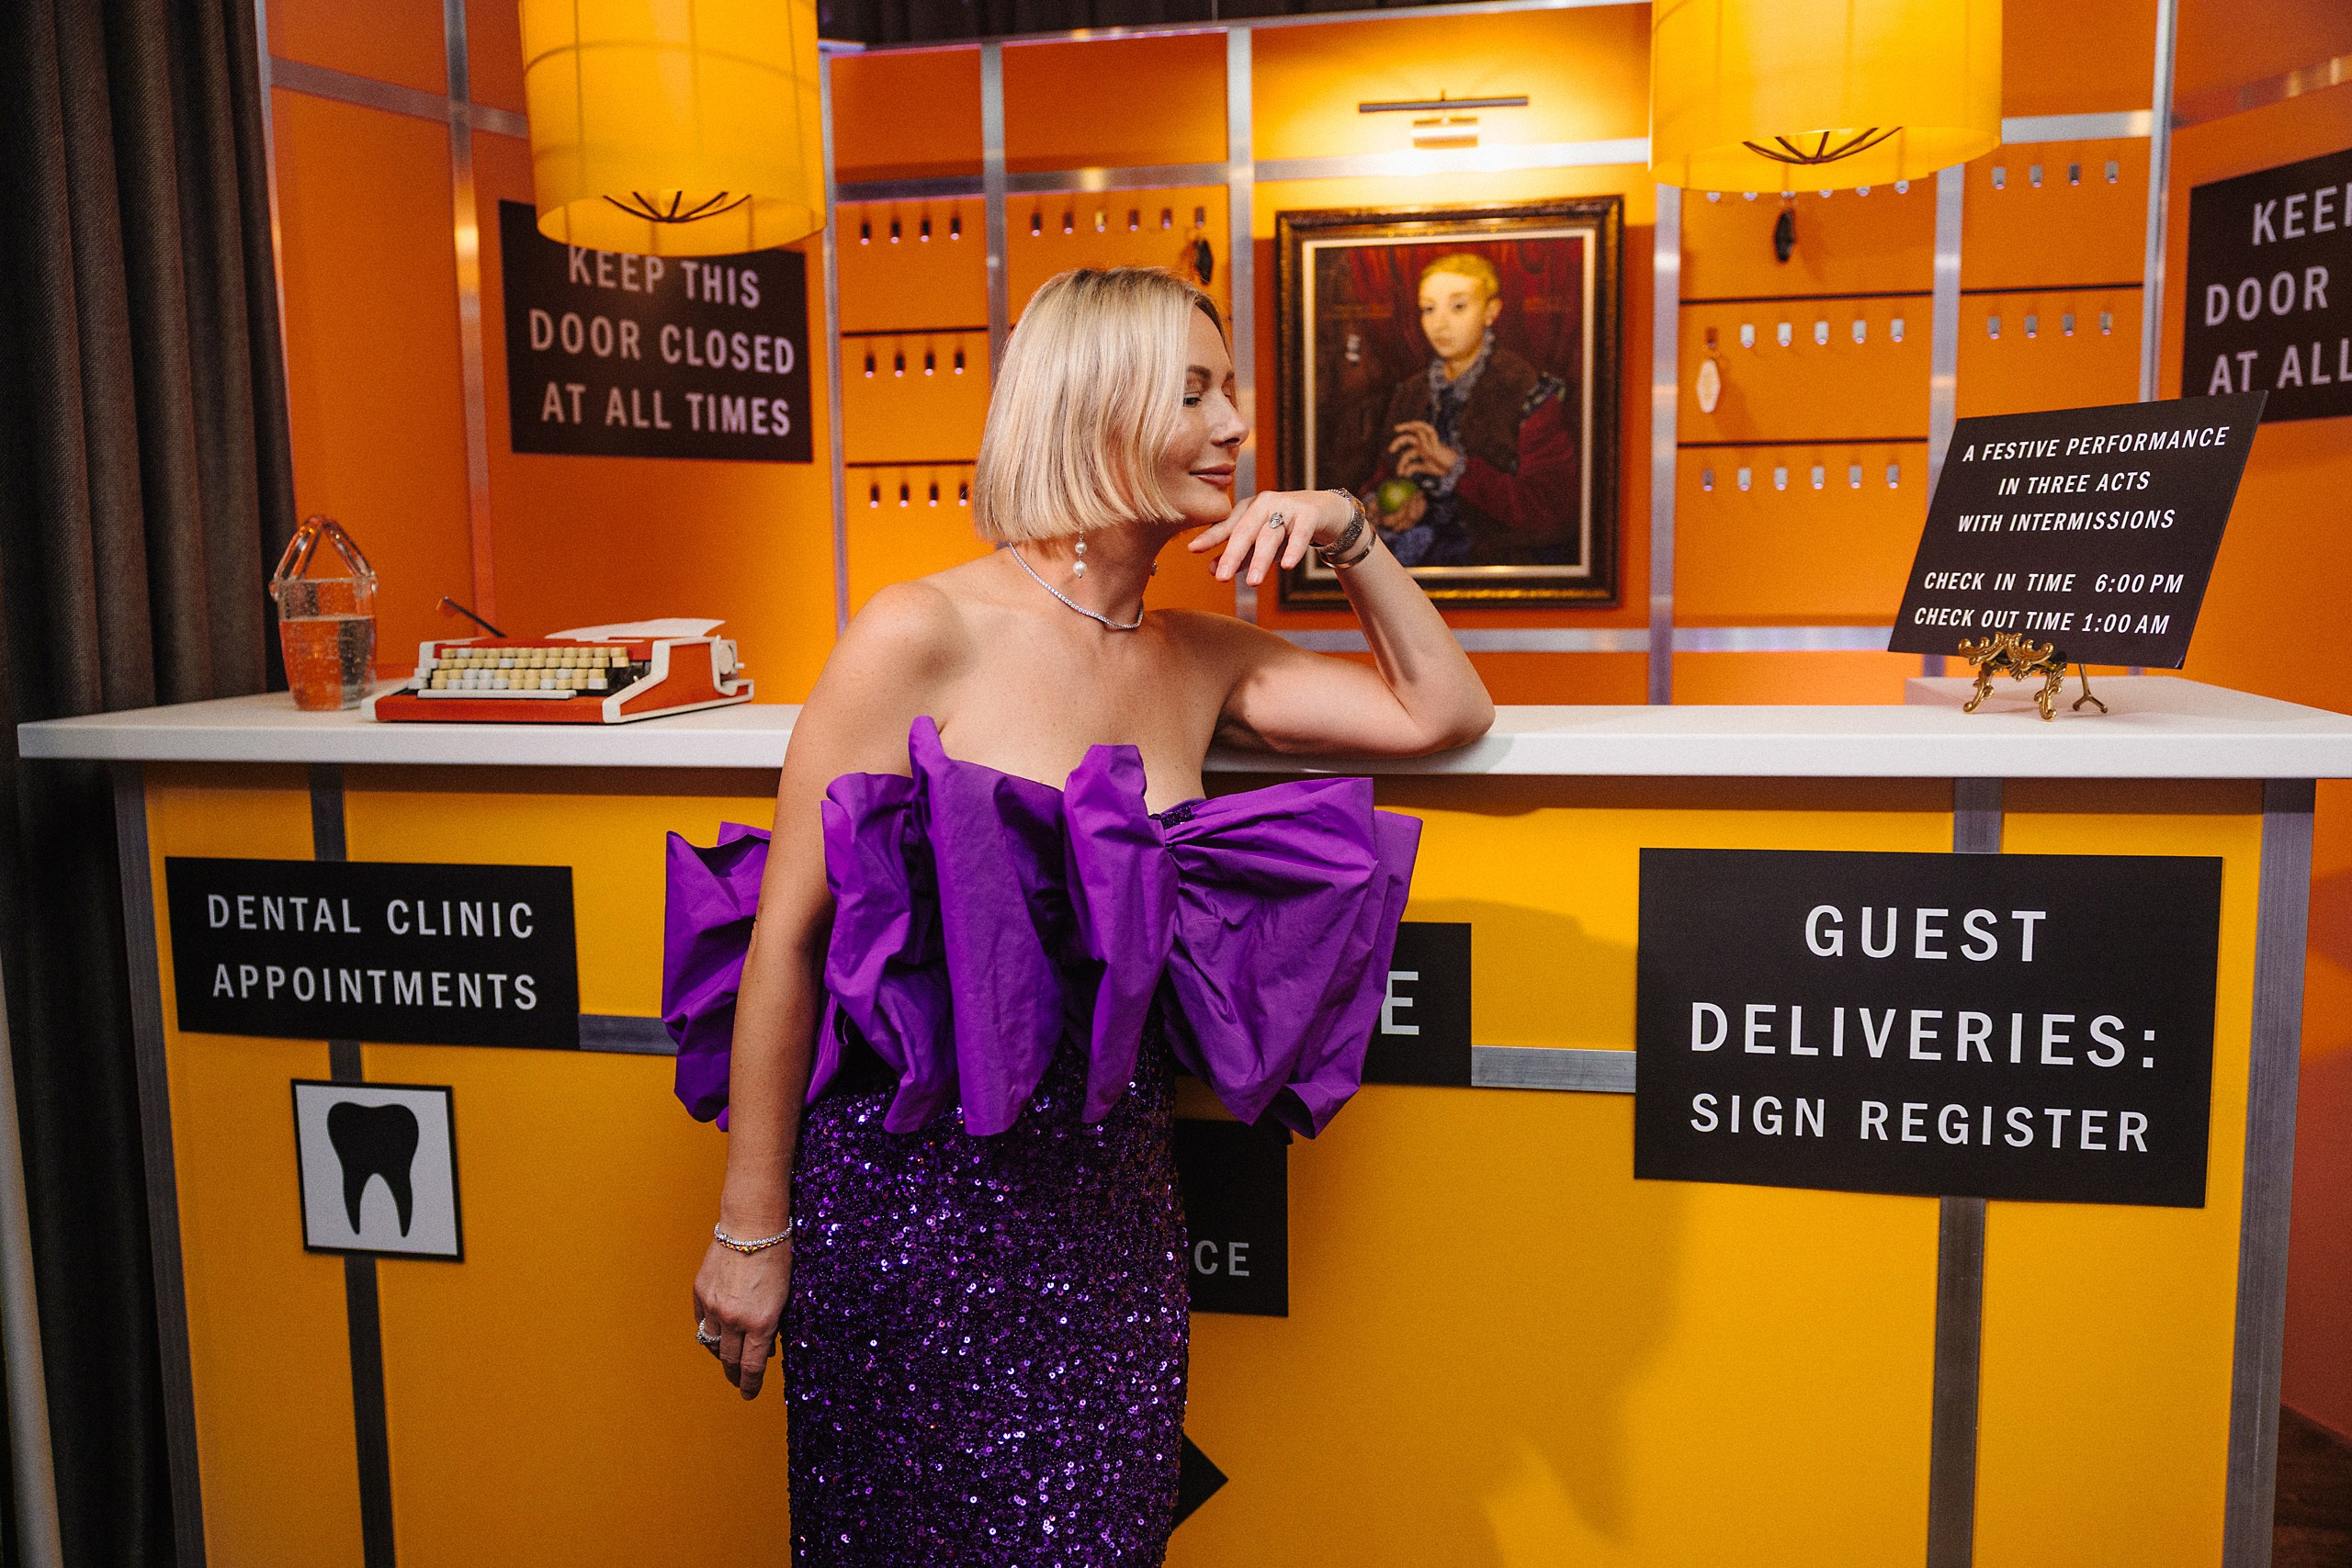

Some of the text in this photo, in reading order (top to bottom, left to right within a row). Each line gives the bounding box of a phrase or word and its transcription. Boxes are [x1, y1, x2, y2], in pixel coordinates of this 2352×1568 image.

[568, 244, 760, 309] KEEP THIS
[2205, 265, 2329, 327] DOOR
[530, 309, 795, 375] DOOR CLOSED
[2208, 350, 2258, 395] AT
[541, 381, 790, 436] AT ALL TIMES
[1962, 425, 2231, 462] A FESTIVE PERFORMANCE
[1997, 470, 2151, 496] IN THREE ACTS
[1958, 509, 2176, 533] WITH INTERMISSIONS
[1924, 571, 2185, 593] CHECK IN TIME 6:00 PM
[1914, 606, 2170, 635] CHECK OUT TIME 1:00 AM
[208, 894, 533, 939] DENTAL CLINIC
[1804, 904, 2047, 962] GUEST
[212, 964, 537, 1010] APPOINTMENTS
[1690, 1001, 2155, 1068] DELIVERIES:
[1690, 1092, 2148, 1153] SIGN REGISTER
